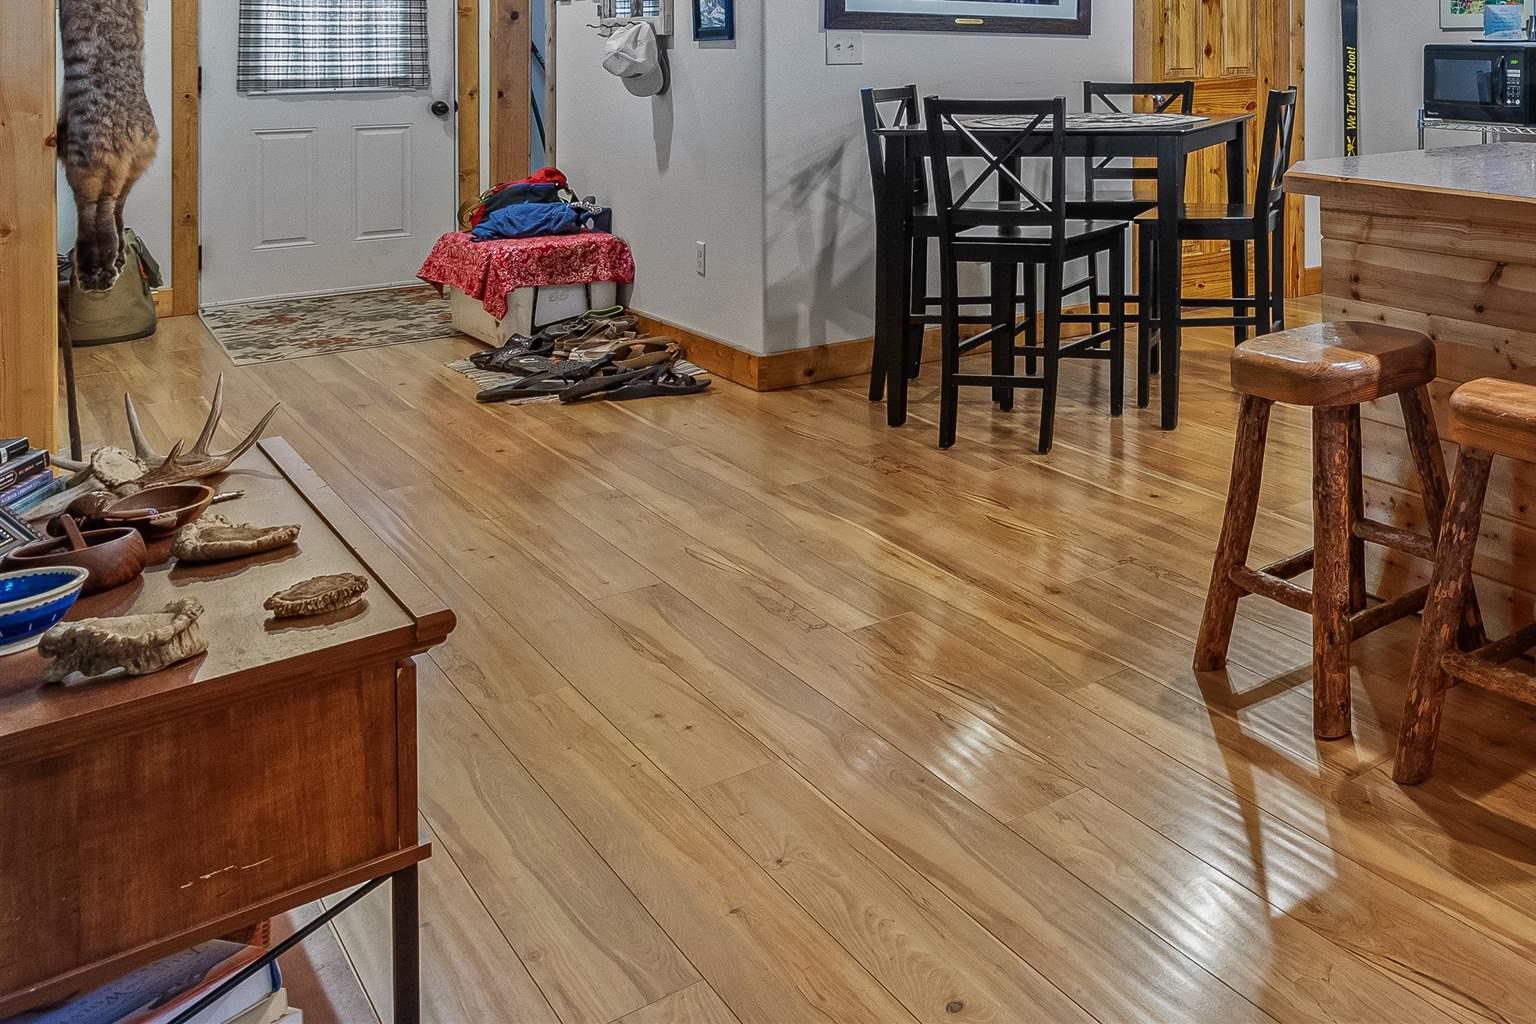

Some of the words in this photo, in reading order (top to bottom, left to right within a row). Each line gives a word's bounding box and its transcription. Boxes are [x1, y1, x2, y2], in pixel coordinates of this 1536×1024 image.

[1346, 46, 1356, 73] Knot!
[1346, 75, 1356, 91] the
[1346, 93, 1356, 113] Tied
[1346, 115, 1356, 129] We
